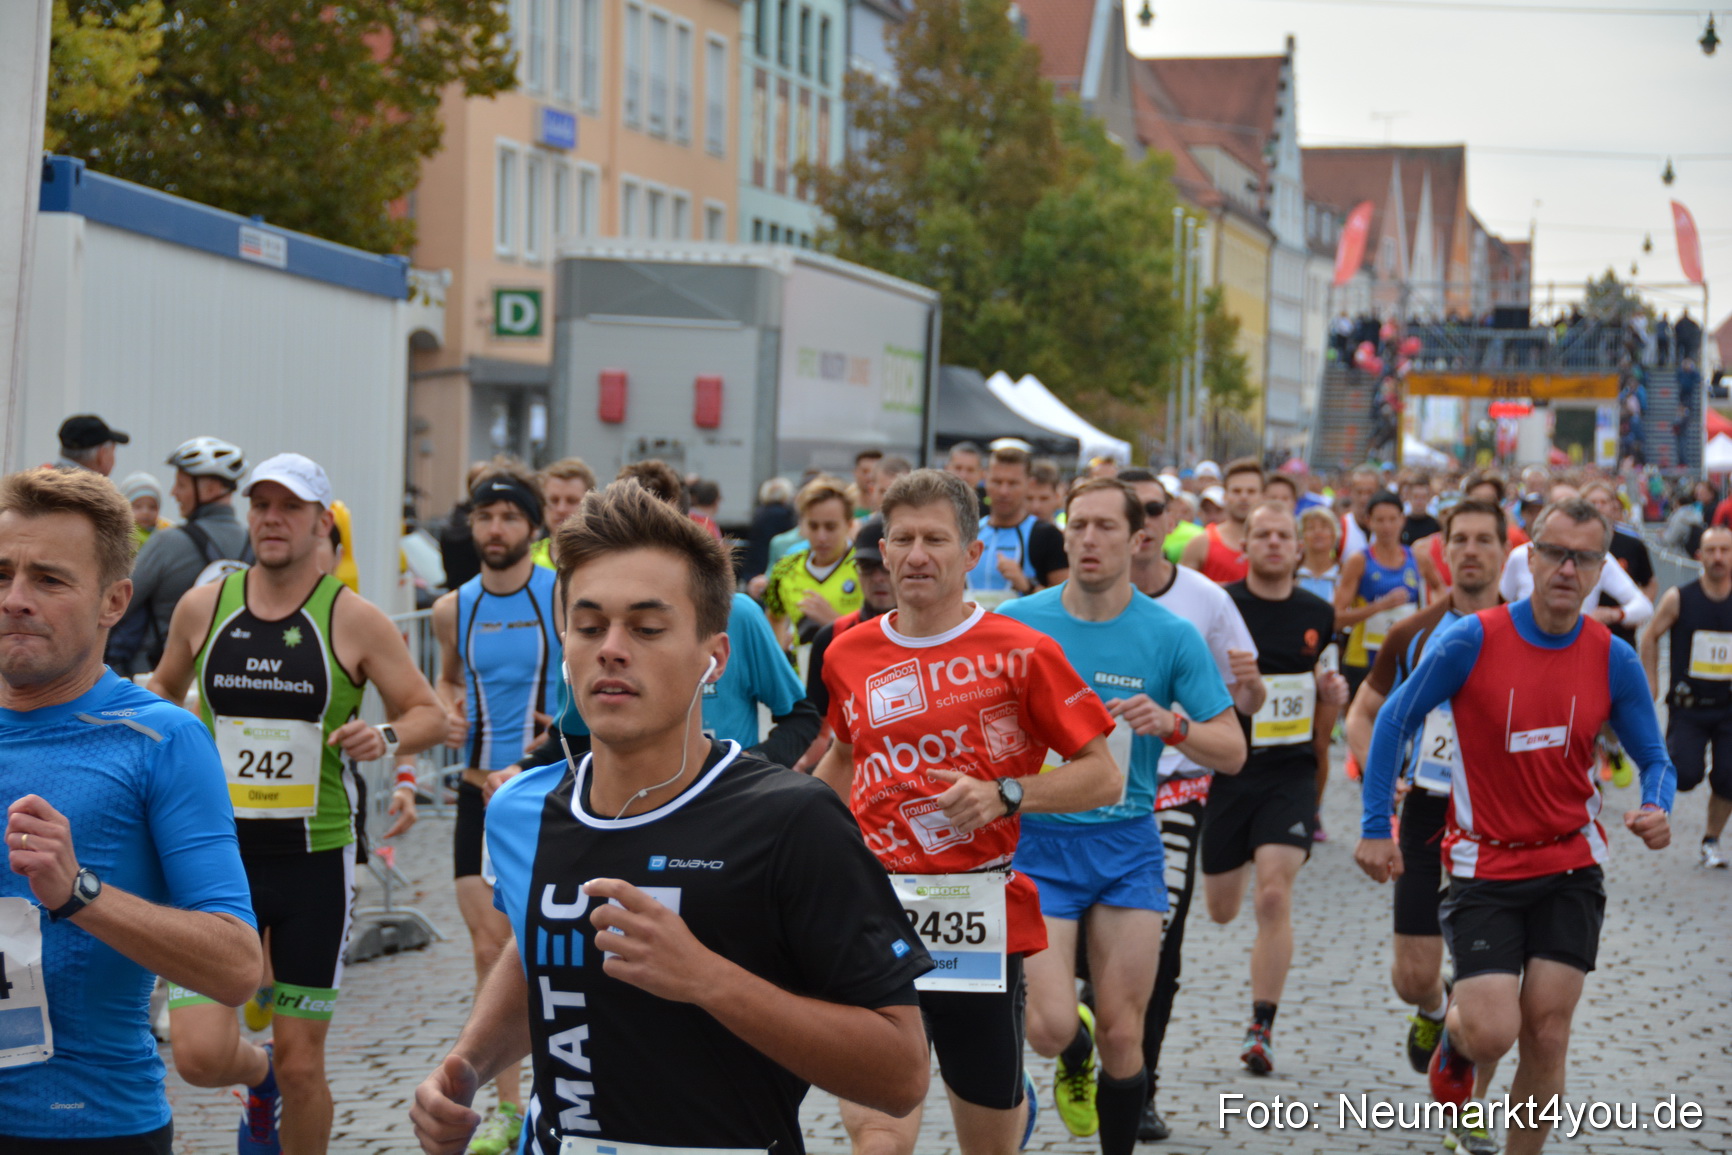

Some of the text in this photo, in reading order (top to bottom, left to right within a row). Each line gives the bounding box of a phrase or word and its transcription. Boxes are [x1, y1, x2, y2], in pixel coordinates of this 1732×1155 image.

[500, 294, 537, 333] D
[246, 657, 283, 673] DAV
[213, 674, 315, 694] Röthenbach
[870, 664, 916, 689] raumbox
[1094, 671, 1144, 689] BOCK
[936, 685, 1001, 709] schenken
[1270, 695, 1304, 718] 136
[238, 749, 294, 779] 242
[248, 790, 280, 801] Oliver
[869, 779, 918, 805] wohnen
[929, 885, 971, 897] BOCK
[933, 956, 958, 970] osef
